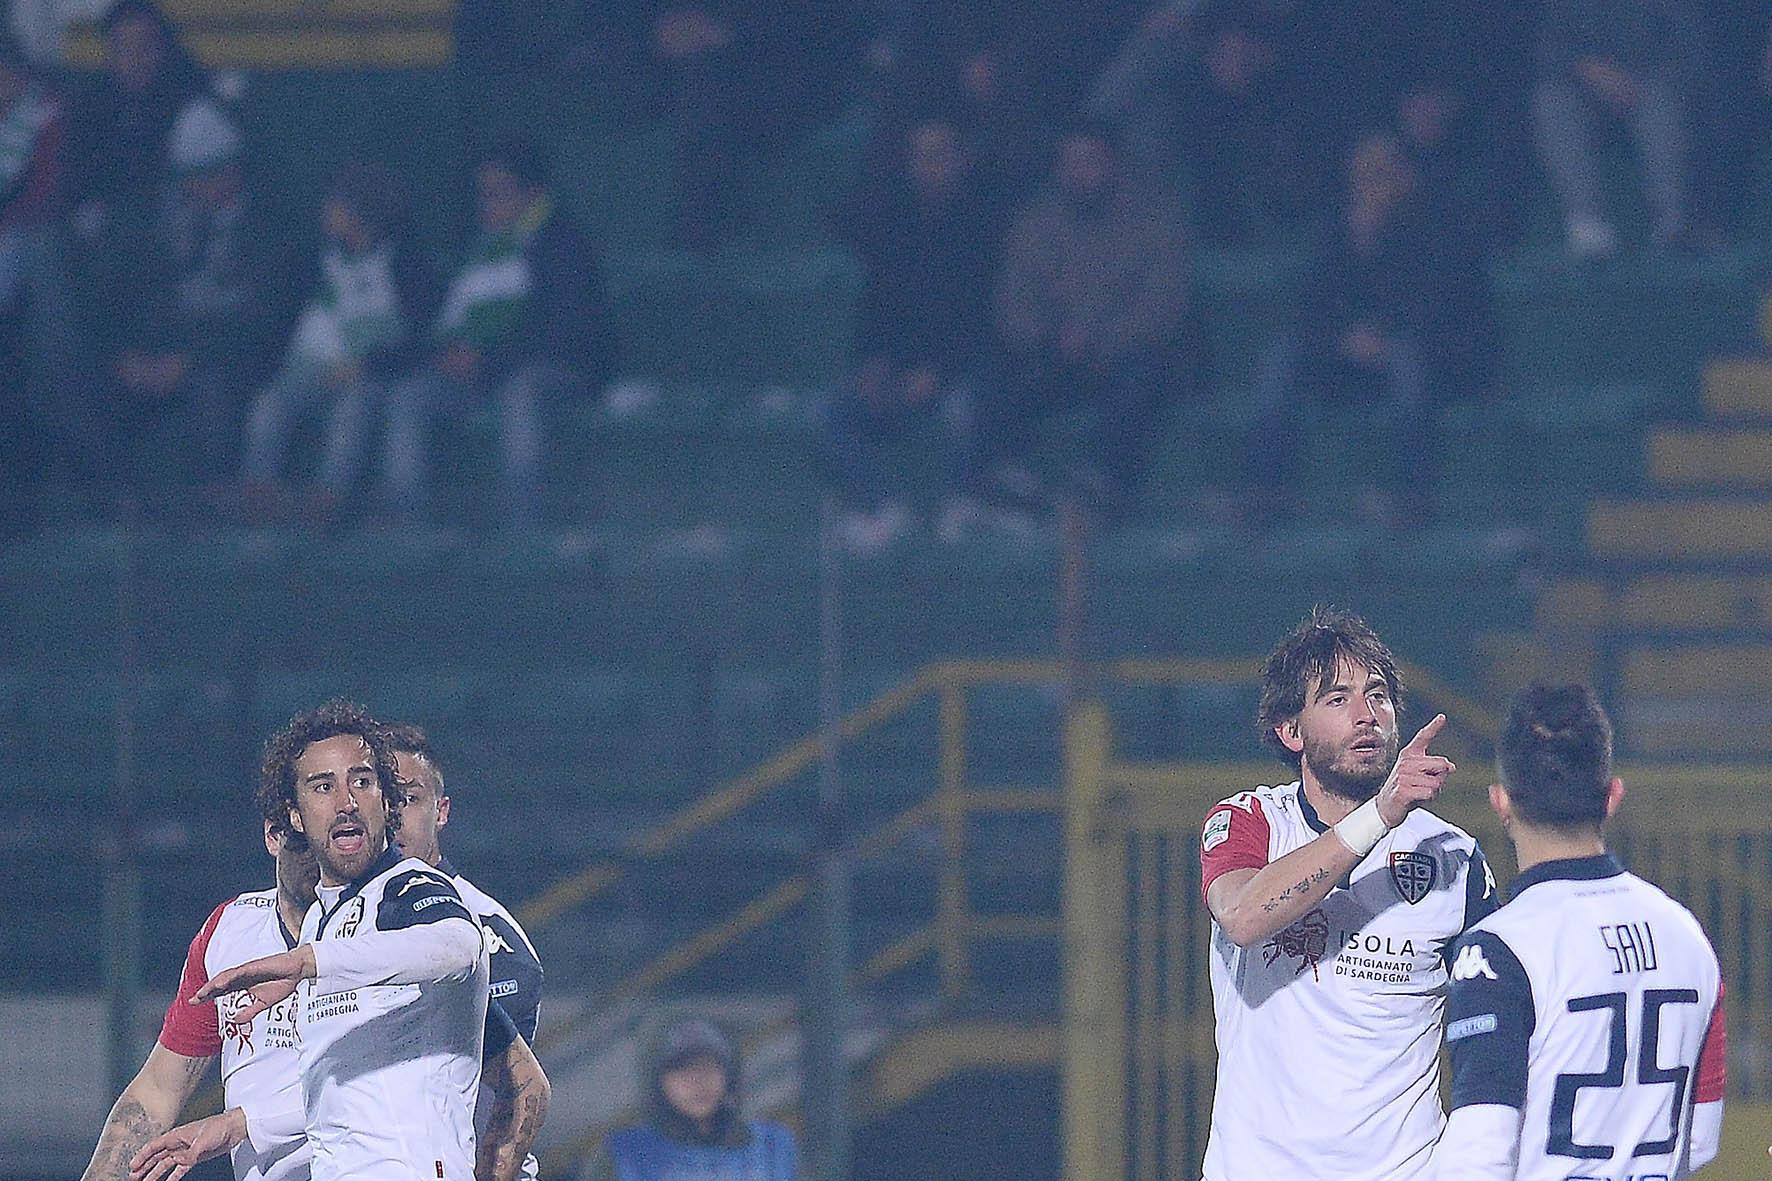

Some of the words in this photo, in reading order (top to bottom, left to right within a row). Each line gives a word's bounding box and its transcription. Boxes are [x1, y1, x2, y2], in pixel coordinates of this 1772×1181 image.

[1340, 930, 1416, 958] ISOLA
[1599, 921, 1658, 974] SAU
[1337, 954, 1413, 972] ARTIGIANATO
[1335, 966, 1347, 977] DI
[1350, 968, 1411, 983] SARDEGNA
[307, 992, 357, 1011] ARTIGIANATO
[316, 1004, 359, 1022] SARDEGNA
[1546, 988, 1699, 1160] 25
